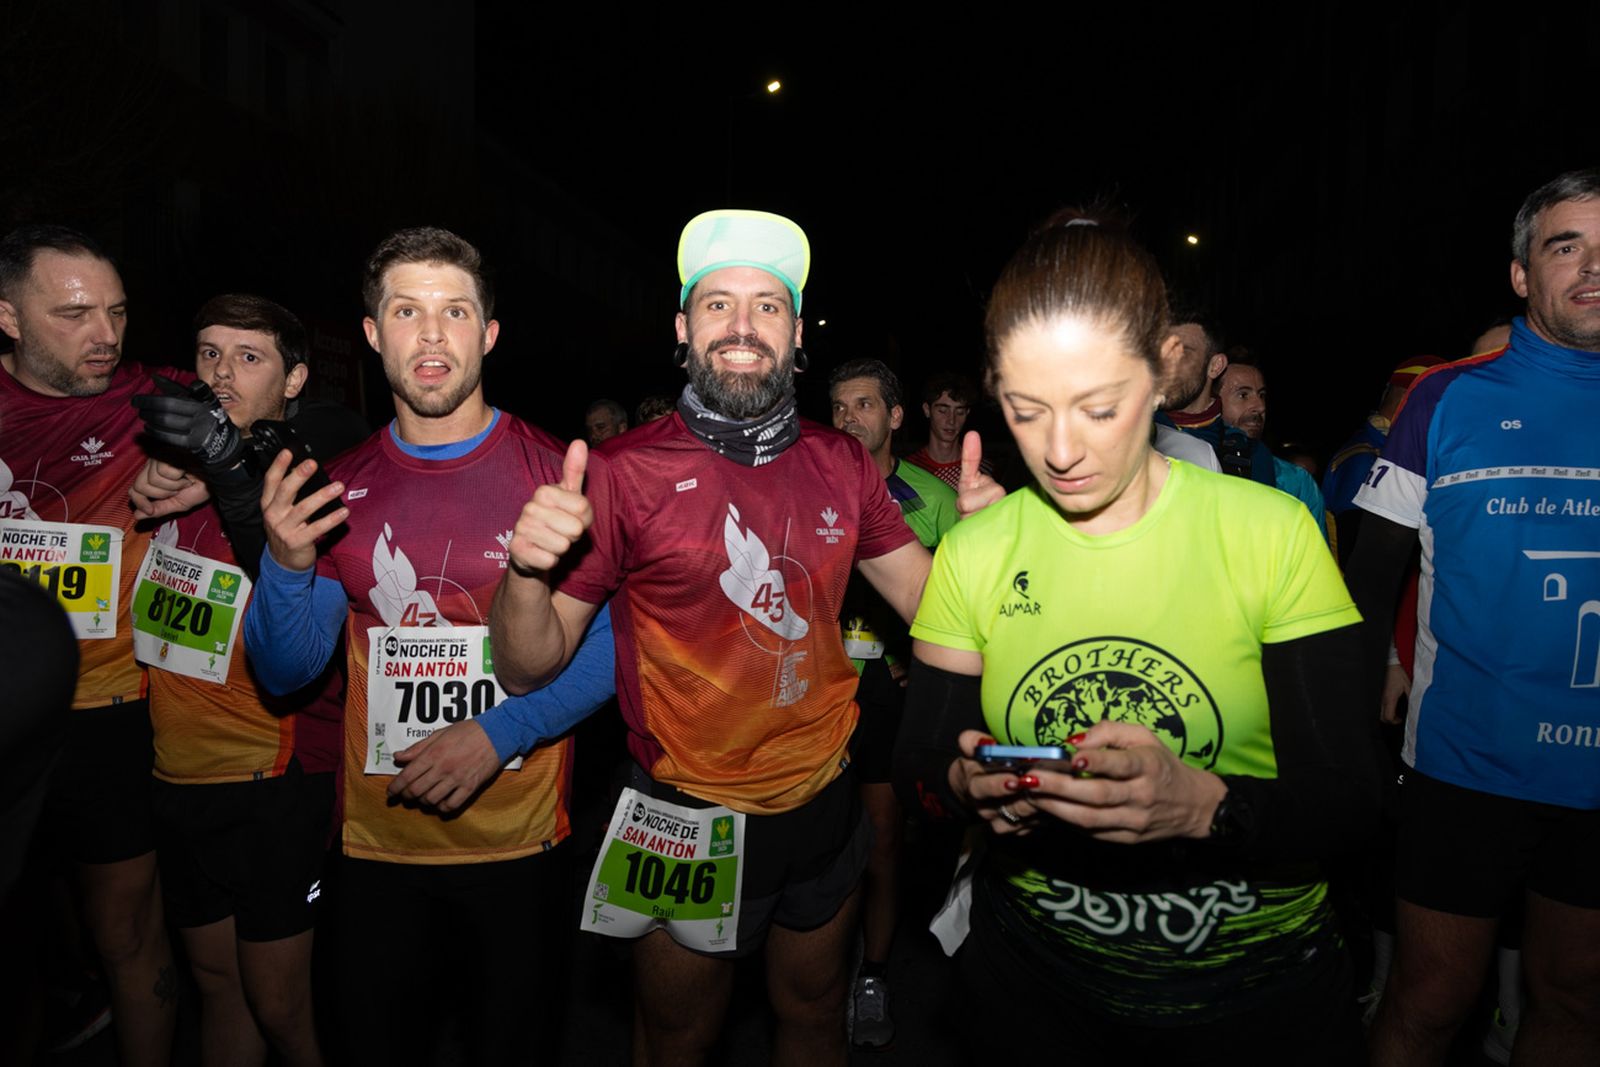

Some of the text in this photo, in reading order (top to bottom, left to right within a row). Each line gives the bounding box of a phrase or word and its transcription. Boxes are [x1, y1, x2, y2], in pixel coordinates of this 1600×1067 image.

[1486, 497, 1529, 515] Club
[1535, 497, 1557, 515] de
[1, 532, 67, 547] NOCHE DE
[15, 545, 67, 562] ANTÓN
[163, 559, 188, 577] NOCHE
[187, 568, 202, 581] DE
[166, 575, 198, 596] ANTÓN
[148, 587, 213, 637] 8120
[751, 583, 785, 623] 43
[385, 639, 399, 652] 43
[400, 644, 468, 658] NOCHE DE
[384, 662, 412, 677] SAN
[414, 658, 468, 677] ANTÓN
[1023, 644, 1201, 709] BROTHERS
[395, 679, 496, 725] 7030
[643, 814, 681, 836] NOCHE
[680, 826, 700, 840] DE
[622, 826, 650, 847] SAN
[646, 837, 697, 859] ANTÓN
[625, 851, 717, 905] 1046
[651, 904, 675, 919] Raúl
